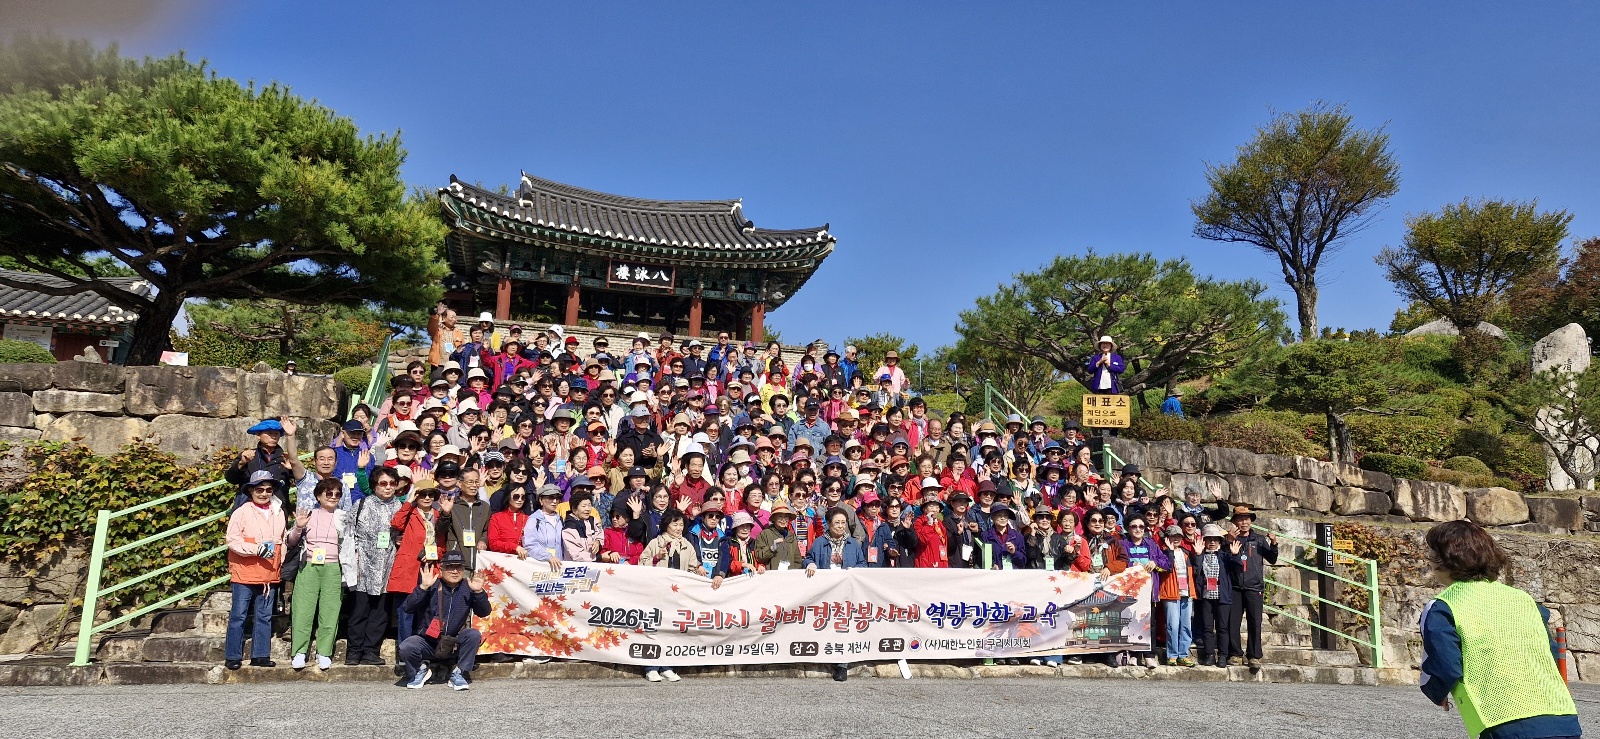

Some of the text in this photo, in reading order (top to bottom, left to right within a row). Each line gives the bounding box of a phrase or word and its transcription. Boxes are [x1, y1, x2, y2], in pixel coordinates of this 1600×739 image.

[1087, 397, 1126, 407] 매표소
[1087, 409, 1116, 417] 계단으로
[562, 566, 588, 578] 도전
[535, 579, 592, 594] 빛나는 구리
[587, 605, 661, 632] 2026년
[672, 608, 750, 633] 구리시
[759, 600, 921, 635] 실버경찰봉사대
[926, 601, 1013, 629] 역량강화
[665, 645, 706, 657] 2026년
[711, 644, 734, 657] 10월
[738, 643, 779, 656] 15일(목)
[823, 642, 844, 655] 충북
[847, 640, 871, 654] 제천시
[924, 638, 984, 651] (사)대한노인회
